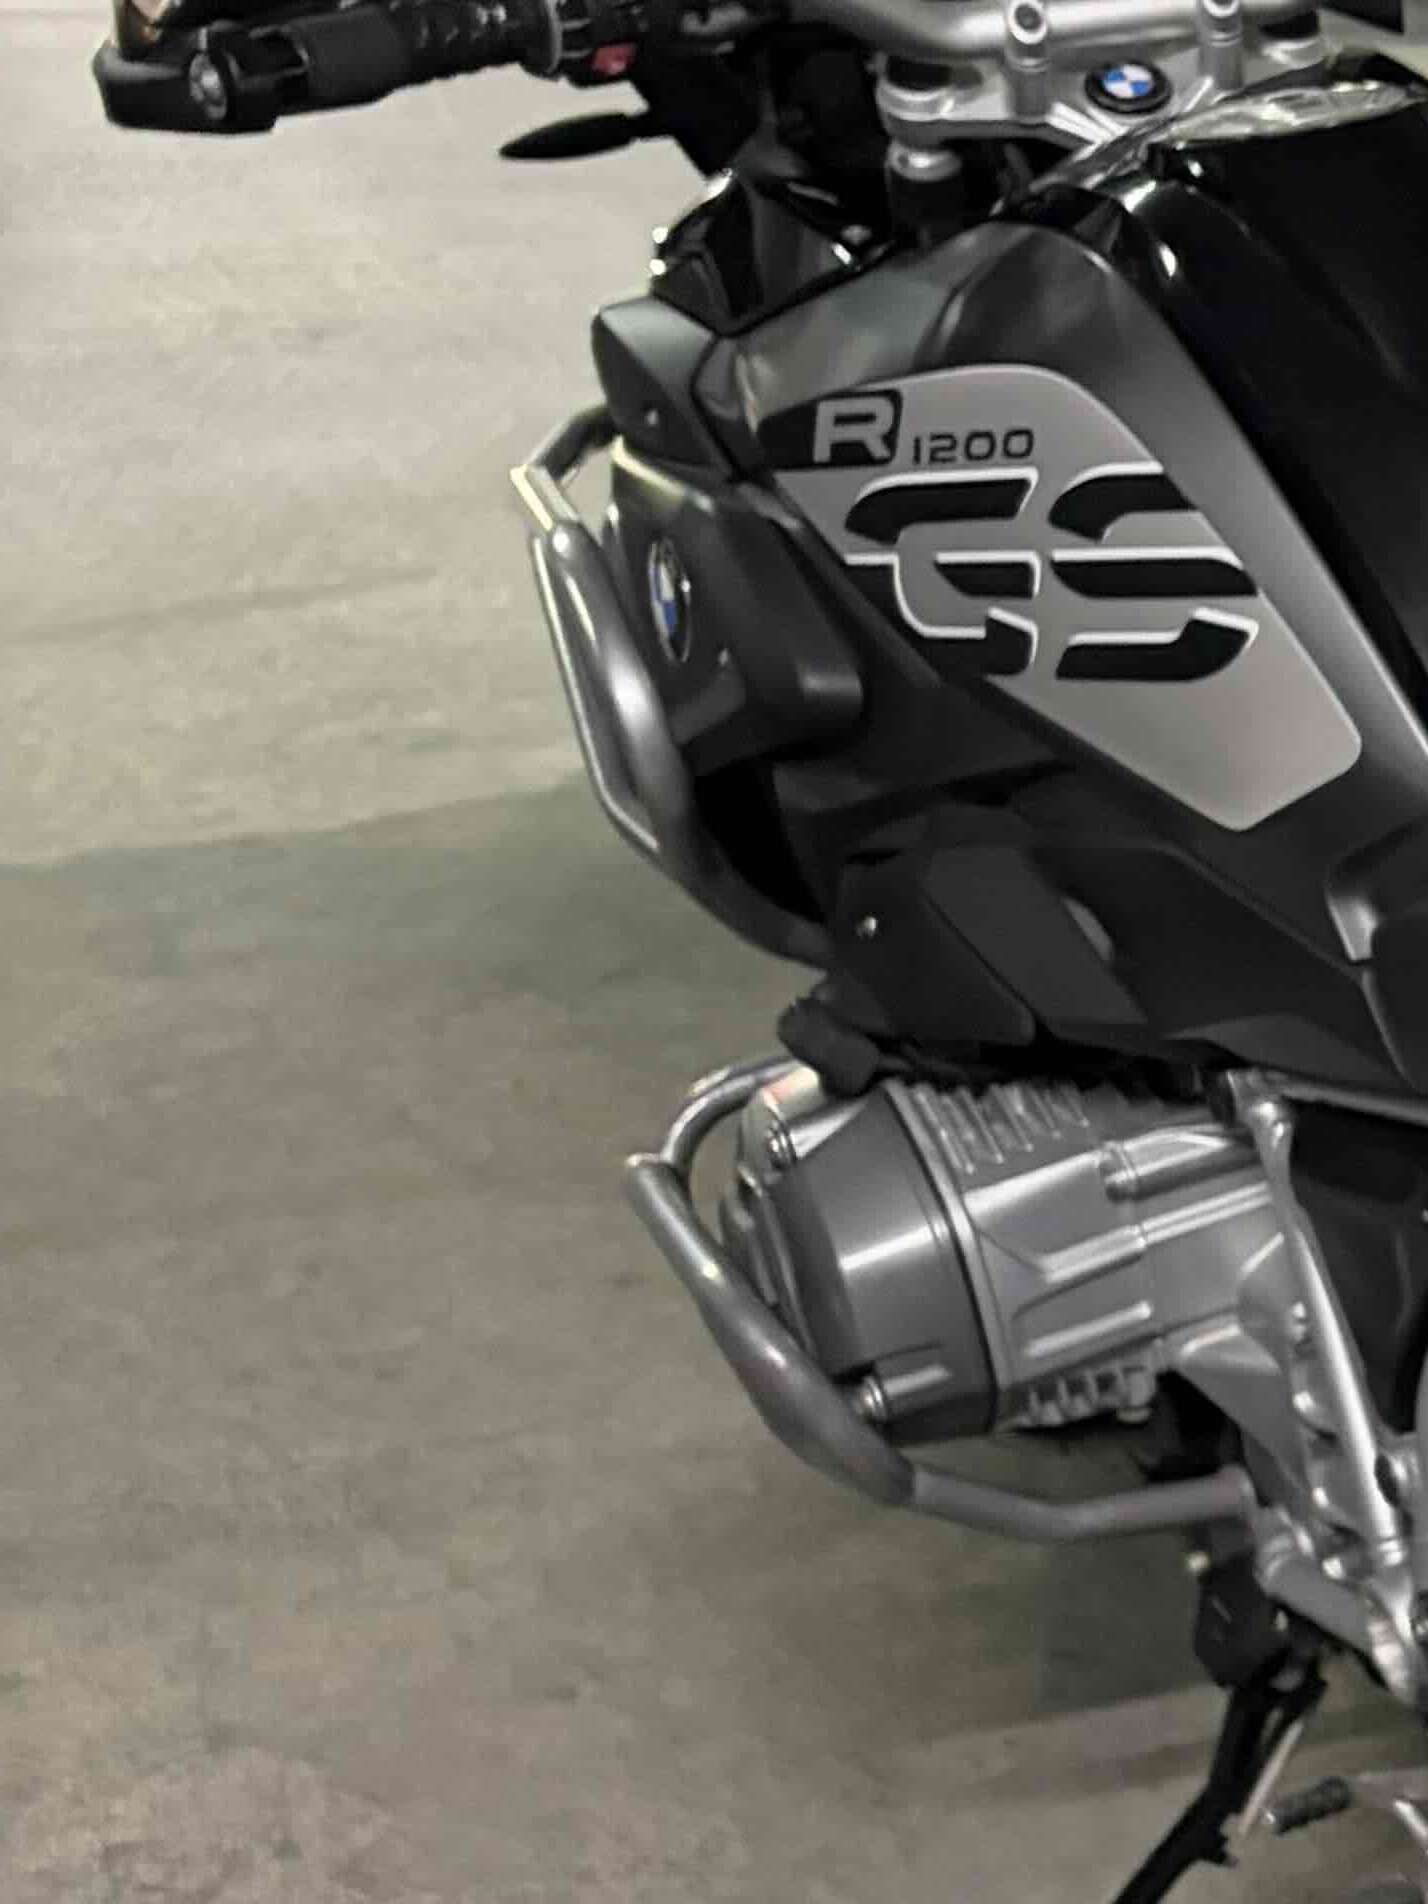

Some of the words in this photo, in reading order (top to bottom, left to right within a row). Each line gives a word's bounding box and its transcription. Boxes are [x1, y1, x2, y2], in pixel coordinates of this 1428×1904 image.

[812, 397, 897, 464] R
[912, 428, 1035, 464] 1200
[844, 466, 1260, 683] GS
